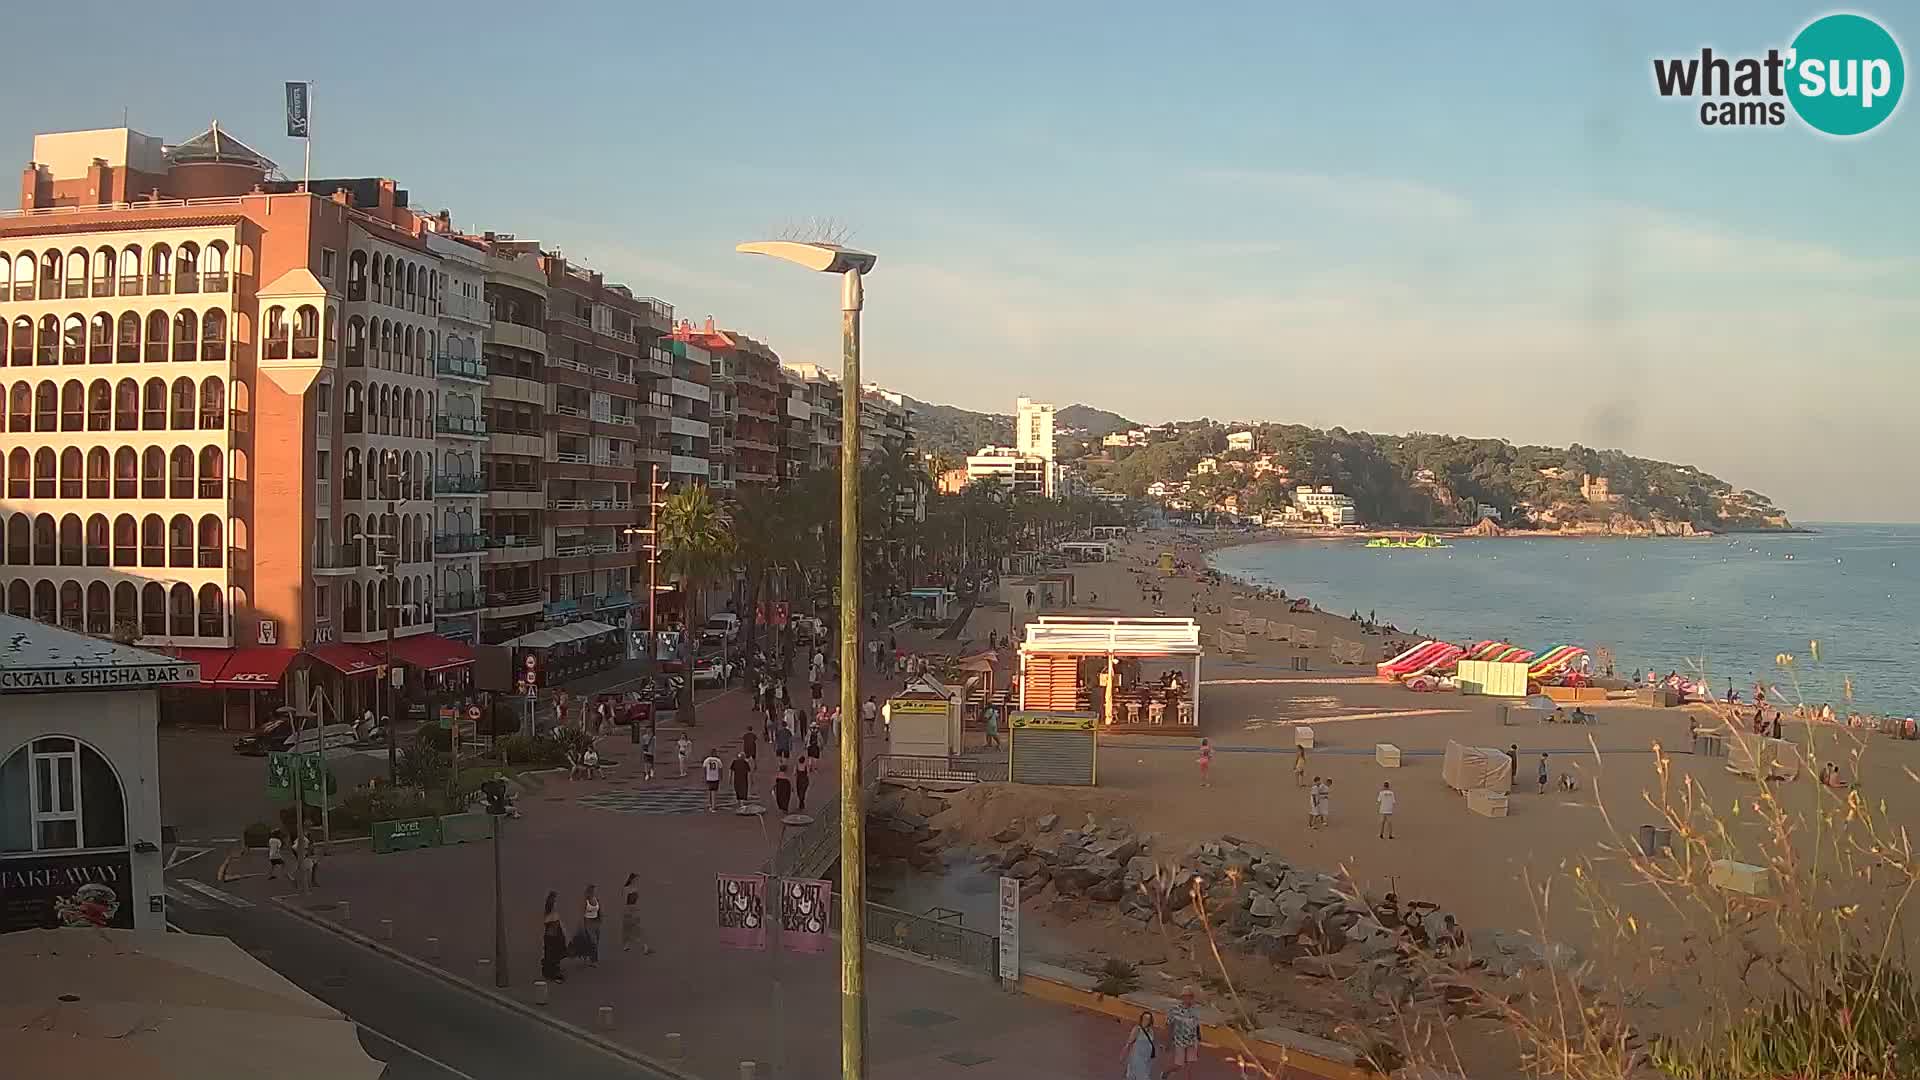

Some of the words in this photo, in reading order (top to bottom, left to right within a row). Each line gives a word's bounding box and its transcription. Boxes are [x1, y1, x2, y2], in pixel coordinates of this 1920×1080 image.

[314, 626, 333, 643] KFC
[64, 671, 77, 685] &
[81, 669, 142, 684] SHISHA
[148, 667, 180, 682] BAR
[232, 672, 269, 681] KFC
